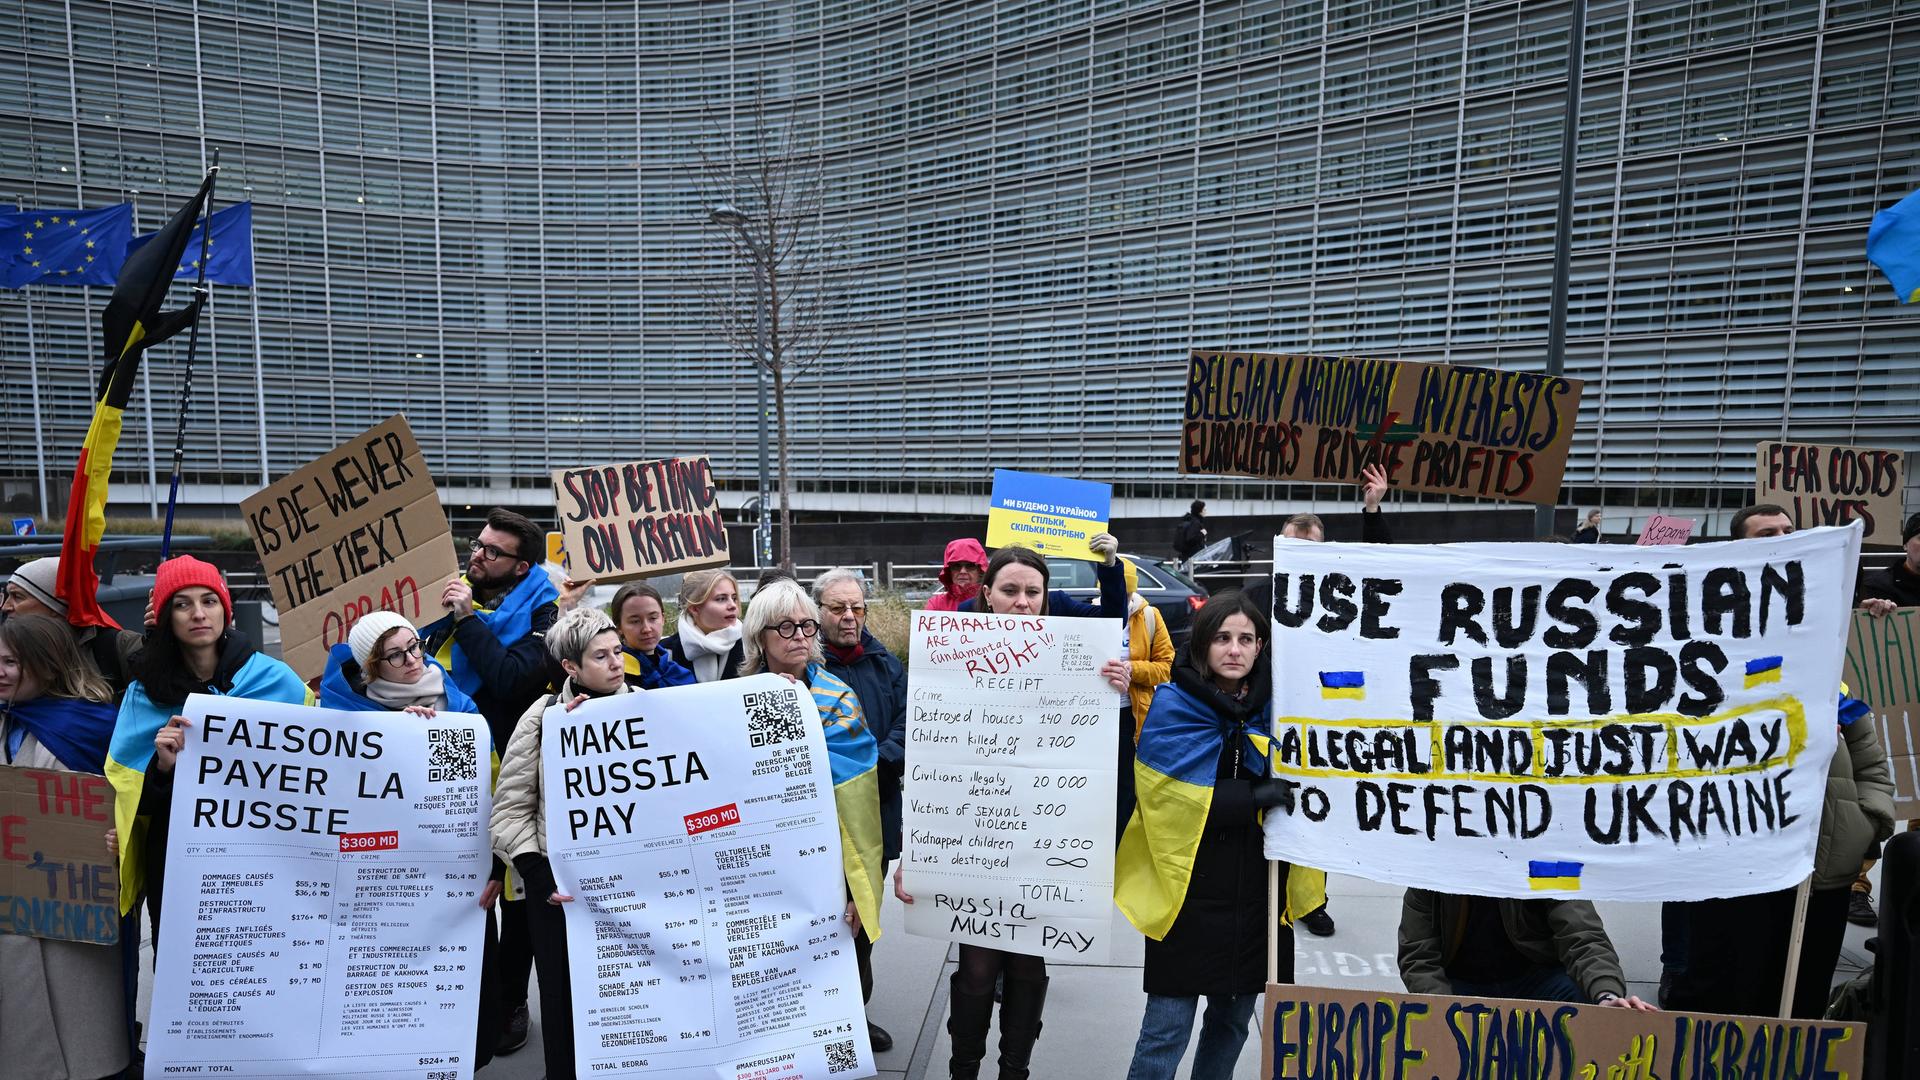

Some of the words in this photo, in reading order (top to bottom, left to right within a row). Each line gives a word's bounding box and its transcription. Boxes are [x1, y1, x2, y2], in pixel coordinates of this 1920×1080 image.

[1186, 353, 1295, 425] BELGIAN
[1290, 357, 1402, 429] NATIONAL
[1414, 365, 1571, 452] INTERESTS
[1314, 427, 1413, 485] PRIVATE
[1411, 438, 1535, 497] PROFITS
[1769, 443, 1822, 493] FEAR
[1828, 446, 1900, 497] COSTS
[250, 506, 281, 555] IS
[277, 484, 320, 543] DE
[314, 431, 414, 517] WEVER
[563, 466, 621, 523] STOP
[622, 457, 717, 514] BETTING
[1003, 498, 1015, 507] МИ
[1016, 500, 1048, 512] БУДЕМО
[1055, 505, 1098, 518] УКРАЇНОЮ
[1010, 522, 1045, 534] СКІЛЬКИ
[1046, 528, 1086, 540] ПОТРІБНО
[1031, 515, 1067, 528] СТІЛЬКИ,
[582, 522, 625, 574] ON
[628, 510, 727, 568] KREMLIN
[275, 549, 334, 609] THE
[1273, 570, 1402, 640] USE
[1439, 561, 1806, 649] RUSSIAN
[926, 635, 950, 649] ARE
[960, 634, 974, 644] a
[1410, 639, 1729, 723] FUNDS
[913, 688, 943, 702] Crime
[1038, 696, 1067, 707] Number
[1068, 695, 1078, 706] of
[1078, 695, 1101, 706] Cases
[913, 706, 972, 726] Destroyed
[982, 708, 1024, 725] houses
[202, 714, 384, 761] FAISONS
[560, 716, 649, 759] MAKE
[911, 728, 958, 744] Children
[967, 730, 998, 746] killed
[1006, 736, 1020, 747] or
[772, 749, 782, 757] DE
[785, 745, 809, 755] WEVER
[975, 745, 1017, 757] injured
[1281, 725, 1301, 766] A
[1308, 725, 1431, 774] LEGAL
[1446, 724, 1533, 777] AND
[1543, 722, 1664, 778] JUST
[1684, 718, 1783, 768] WAY
[752, 764, 789, 776] RISICO'S
[793, 760, 812, 769] VOOR
[755, 755, 797, 768] OVERSCHAT
[800, 752, 810, 760] DE
[197, 755, 329, 797] PAYER
[357, 771, 405, 801] LA
[564, 751, 710, 799] RUSSIA
[911, 765, 963, 783] Civilians
[969, 771, 1006, 786] illegaly
[22, 770, 109, 823] THE
[424, 793, 462, 802] SURESTIME
[466, 792, 479, 800] LES
[445, 786, 455, 794] DE
[458, 785, 479, 793] WEVER
[968, 785, 1013, 797] detained
[414, 802, 446, 810] RISQUES
[445, 807, 478, 815] BELGIQUE
[910, 799, 949, 815] Victims
[1032, 803, 1067, 817] 500
[1355, 780, 1552, 842] DEFEND
[1583, 768, 1801, 845] UKRAINE
[193, 797, 350, 837] RUSSIE
[568, 802, 637, 841] PAY
[686, 814, 719, 833] $300
[720, 808, 738, 823] MD
[341, 836, 377, 851] $300
[379, 834, 397, 848] MD
[910, 828, 963, 847] Kidnapped
[968, 834, 1014, 850] children
[714, 845, 756, 858] CULTURELE
[760, 843, 771, 851] EN
[715, 850, 772, 864] TOERISTISCHE
[798, 848, 815, 857] $6,9
[818, 845, 827, 853] MD
[911, 850, 939, 864] Lives
[951, 851, 1009, 870] destroyed
[717, 861, 750, 871] VERLIES
[40, 862, 116, 904] THE
[202, 873, 241, 881] DOMMAGES
[245, 872, 274, 880] CAUSÉS
[295, 880, 318, 888] $55,9
[200, 887, 235, 895] HABITÉS
[294, 889, 317, 897] $36,6
[950, 914, 1027, 941] MUST
[1042, 925, 1095, 953] PAY
[731, 971, 760, 981] BEHEER
[764, 967, 779, 976] VAN
[732, 968, 797, 988] EXPLOSIEGEVAAR
[600, 1029, 654, 1041] VERNIETIGING
[601, 1035, 668, 1048] GEZONDHEIDSZORG
[680, 1031, 700, 1040] $16,4
[812, 1028, 833, 1038] 524+
[1445, 1001, 1579, 1080] STANDS
[1670, 1016, 1853, 1080] UKRAINE
[164, 1065, 203, 1073] MONTANT
[418, 1056, 444, 1066] $524+
[448, 1056, 460, 1064] MD
[591, 1062, 618, 1071] TOTAAL
[622, 1059, 649, 1069] BEDRAG
